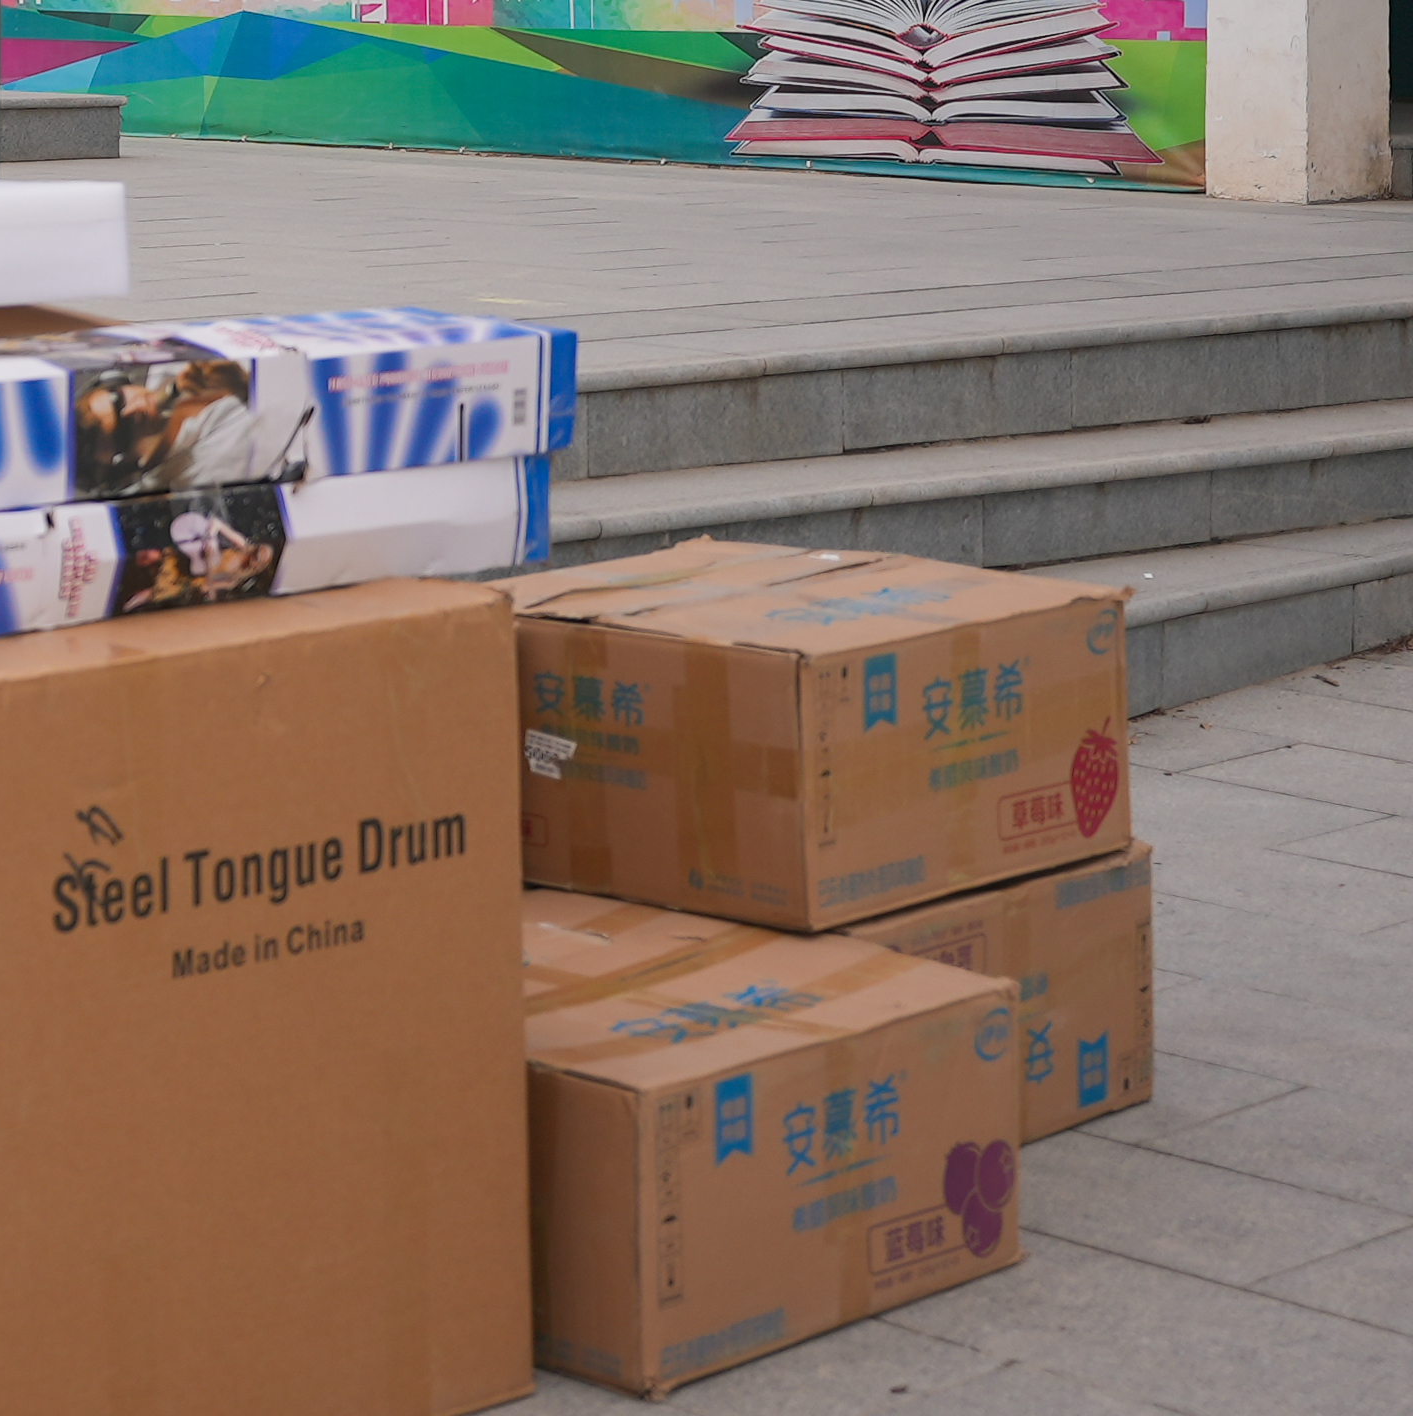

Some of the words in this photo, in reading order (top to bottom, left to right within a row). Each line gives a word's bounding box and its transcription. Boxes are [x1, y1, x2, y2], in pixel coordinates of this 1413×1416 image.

[532, 670, 645, 728] 安慕希
[922, 657, 1023, 741] 安慕希
[1011, 792, 1065, 829] 草莓味
[51, 856, 169, 933] Steel
[183, 836, 344, 905] Tongue
[358, 813, 465, 875] Drum
[172, 939, 246, 979] Made
[254, 934, 279, 964] in
[286, 918, 365, 956] China
[782, 1072, 901, 1177] 安慕希
